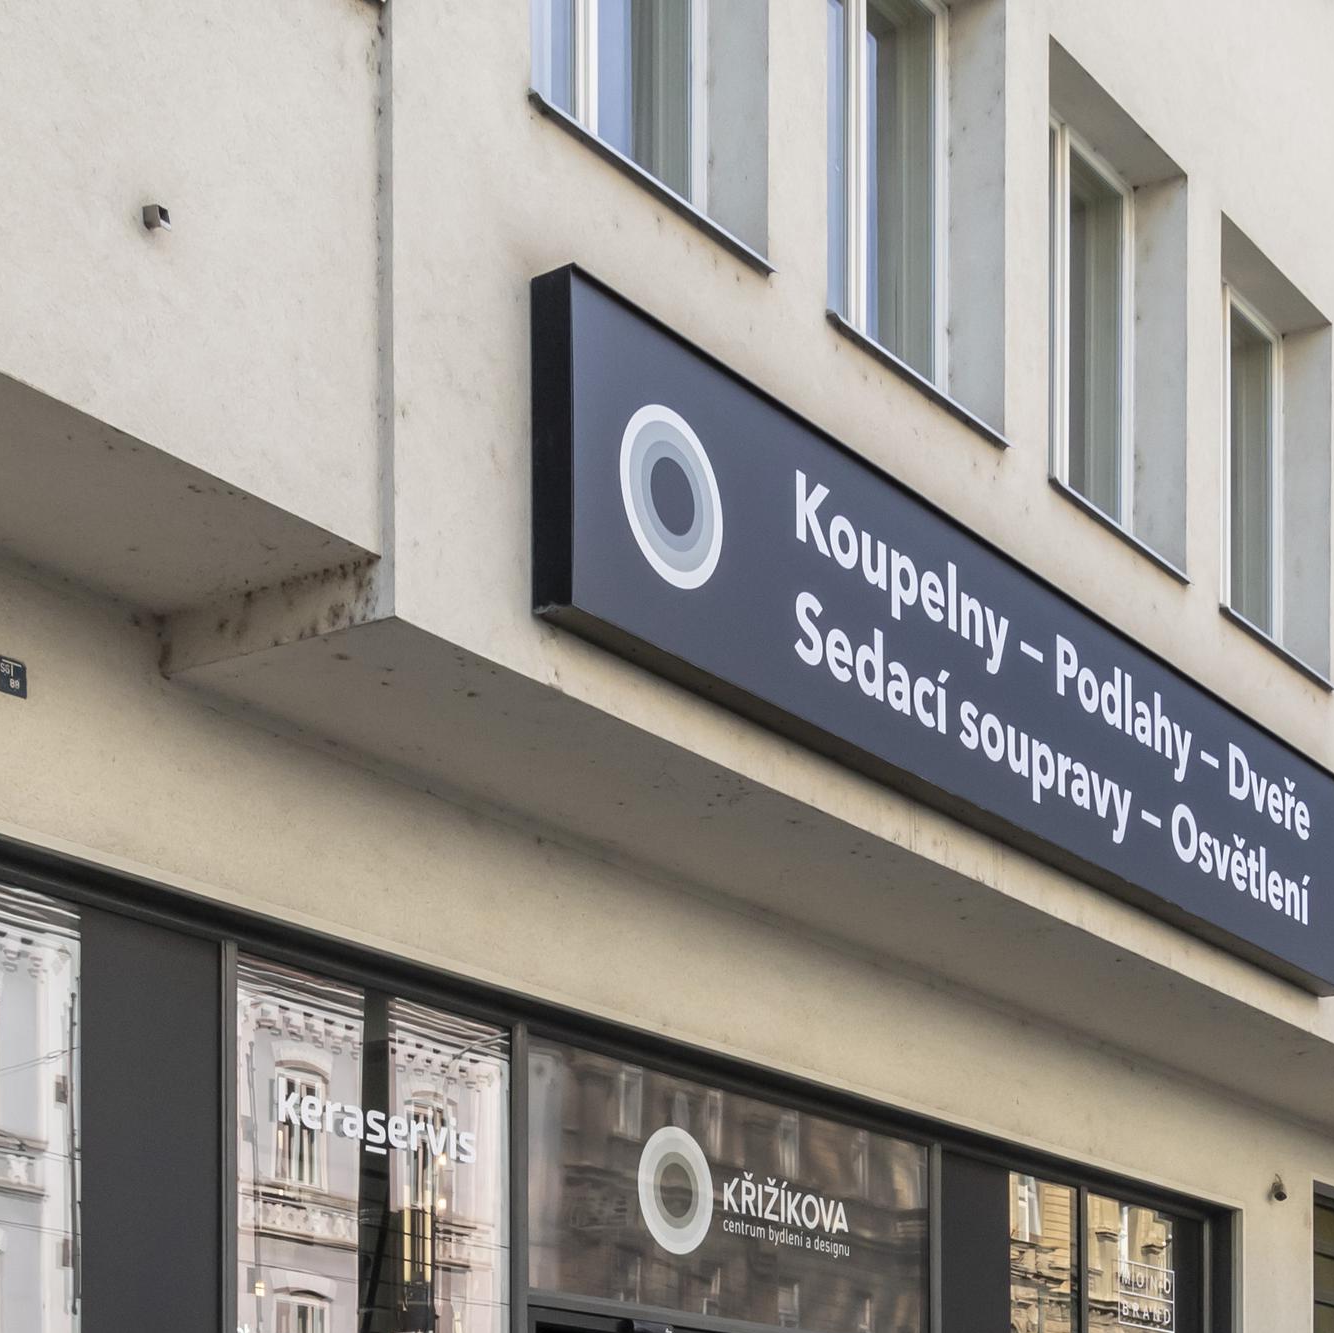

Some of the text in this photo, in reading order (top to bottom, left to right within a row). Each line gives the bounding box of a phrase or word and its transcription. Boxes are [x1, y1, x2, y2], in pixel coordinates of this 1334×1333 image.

[795, 469, 1009, 674] Koupelny
[1055, 635, 1192, 783] Podlahy
[1229, 742, 1312, 841] Dveře
[794, 591, 949, 735] Sedací
[959, 701, 1133, 845] soupravy
[1170, 801, 1311, 927] Osvětlení
[277, 1076, 476, 1164] keraservis
[722, 1218, 850, 1259] centrum bydlení a designu
[723, 1171, 849, 1234] KŘIŽÍKOVA
